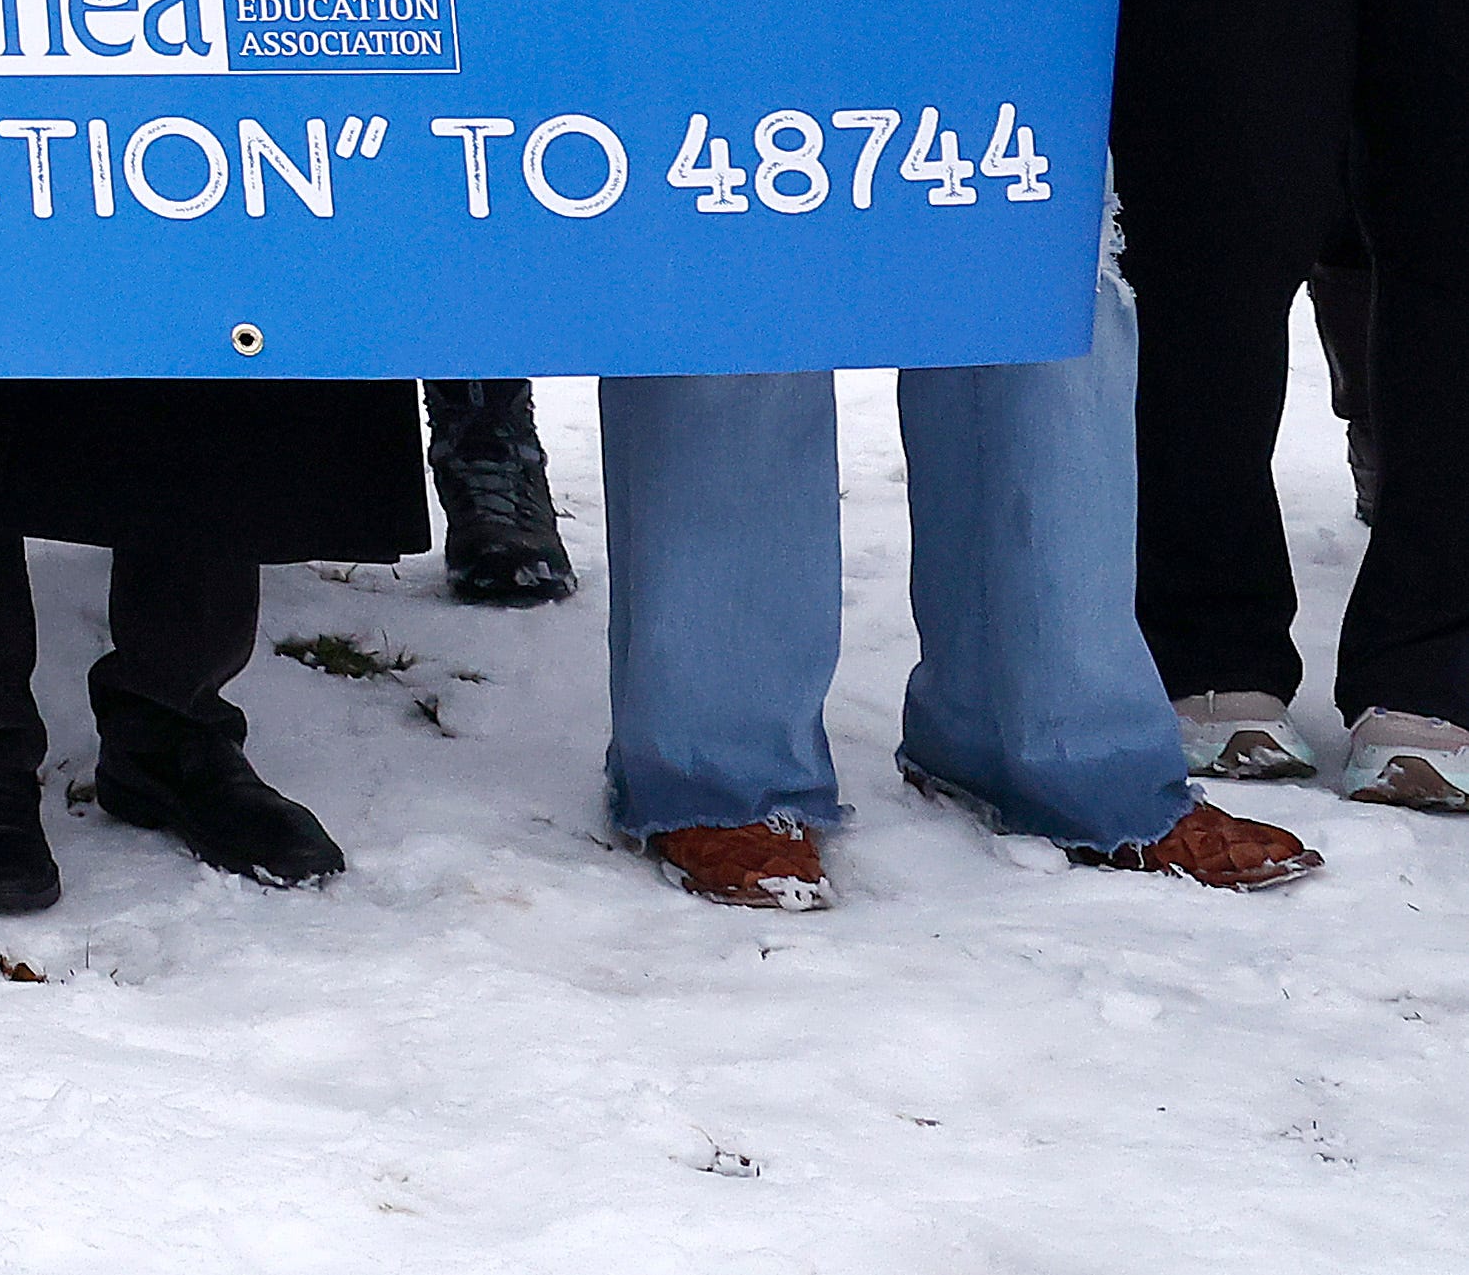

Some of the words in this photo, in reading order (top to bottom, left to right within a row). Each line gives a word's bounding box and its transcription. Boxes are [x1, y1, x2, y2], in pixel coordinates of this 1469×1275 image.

[239, 31, 441, 57] ASSOCIATION
[431, 116, 629, 219] TO
[666, 103, 1052, 214] 48744
